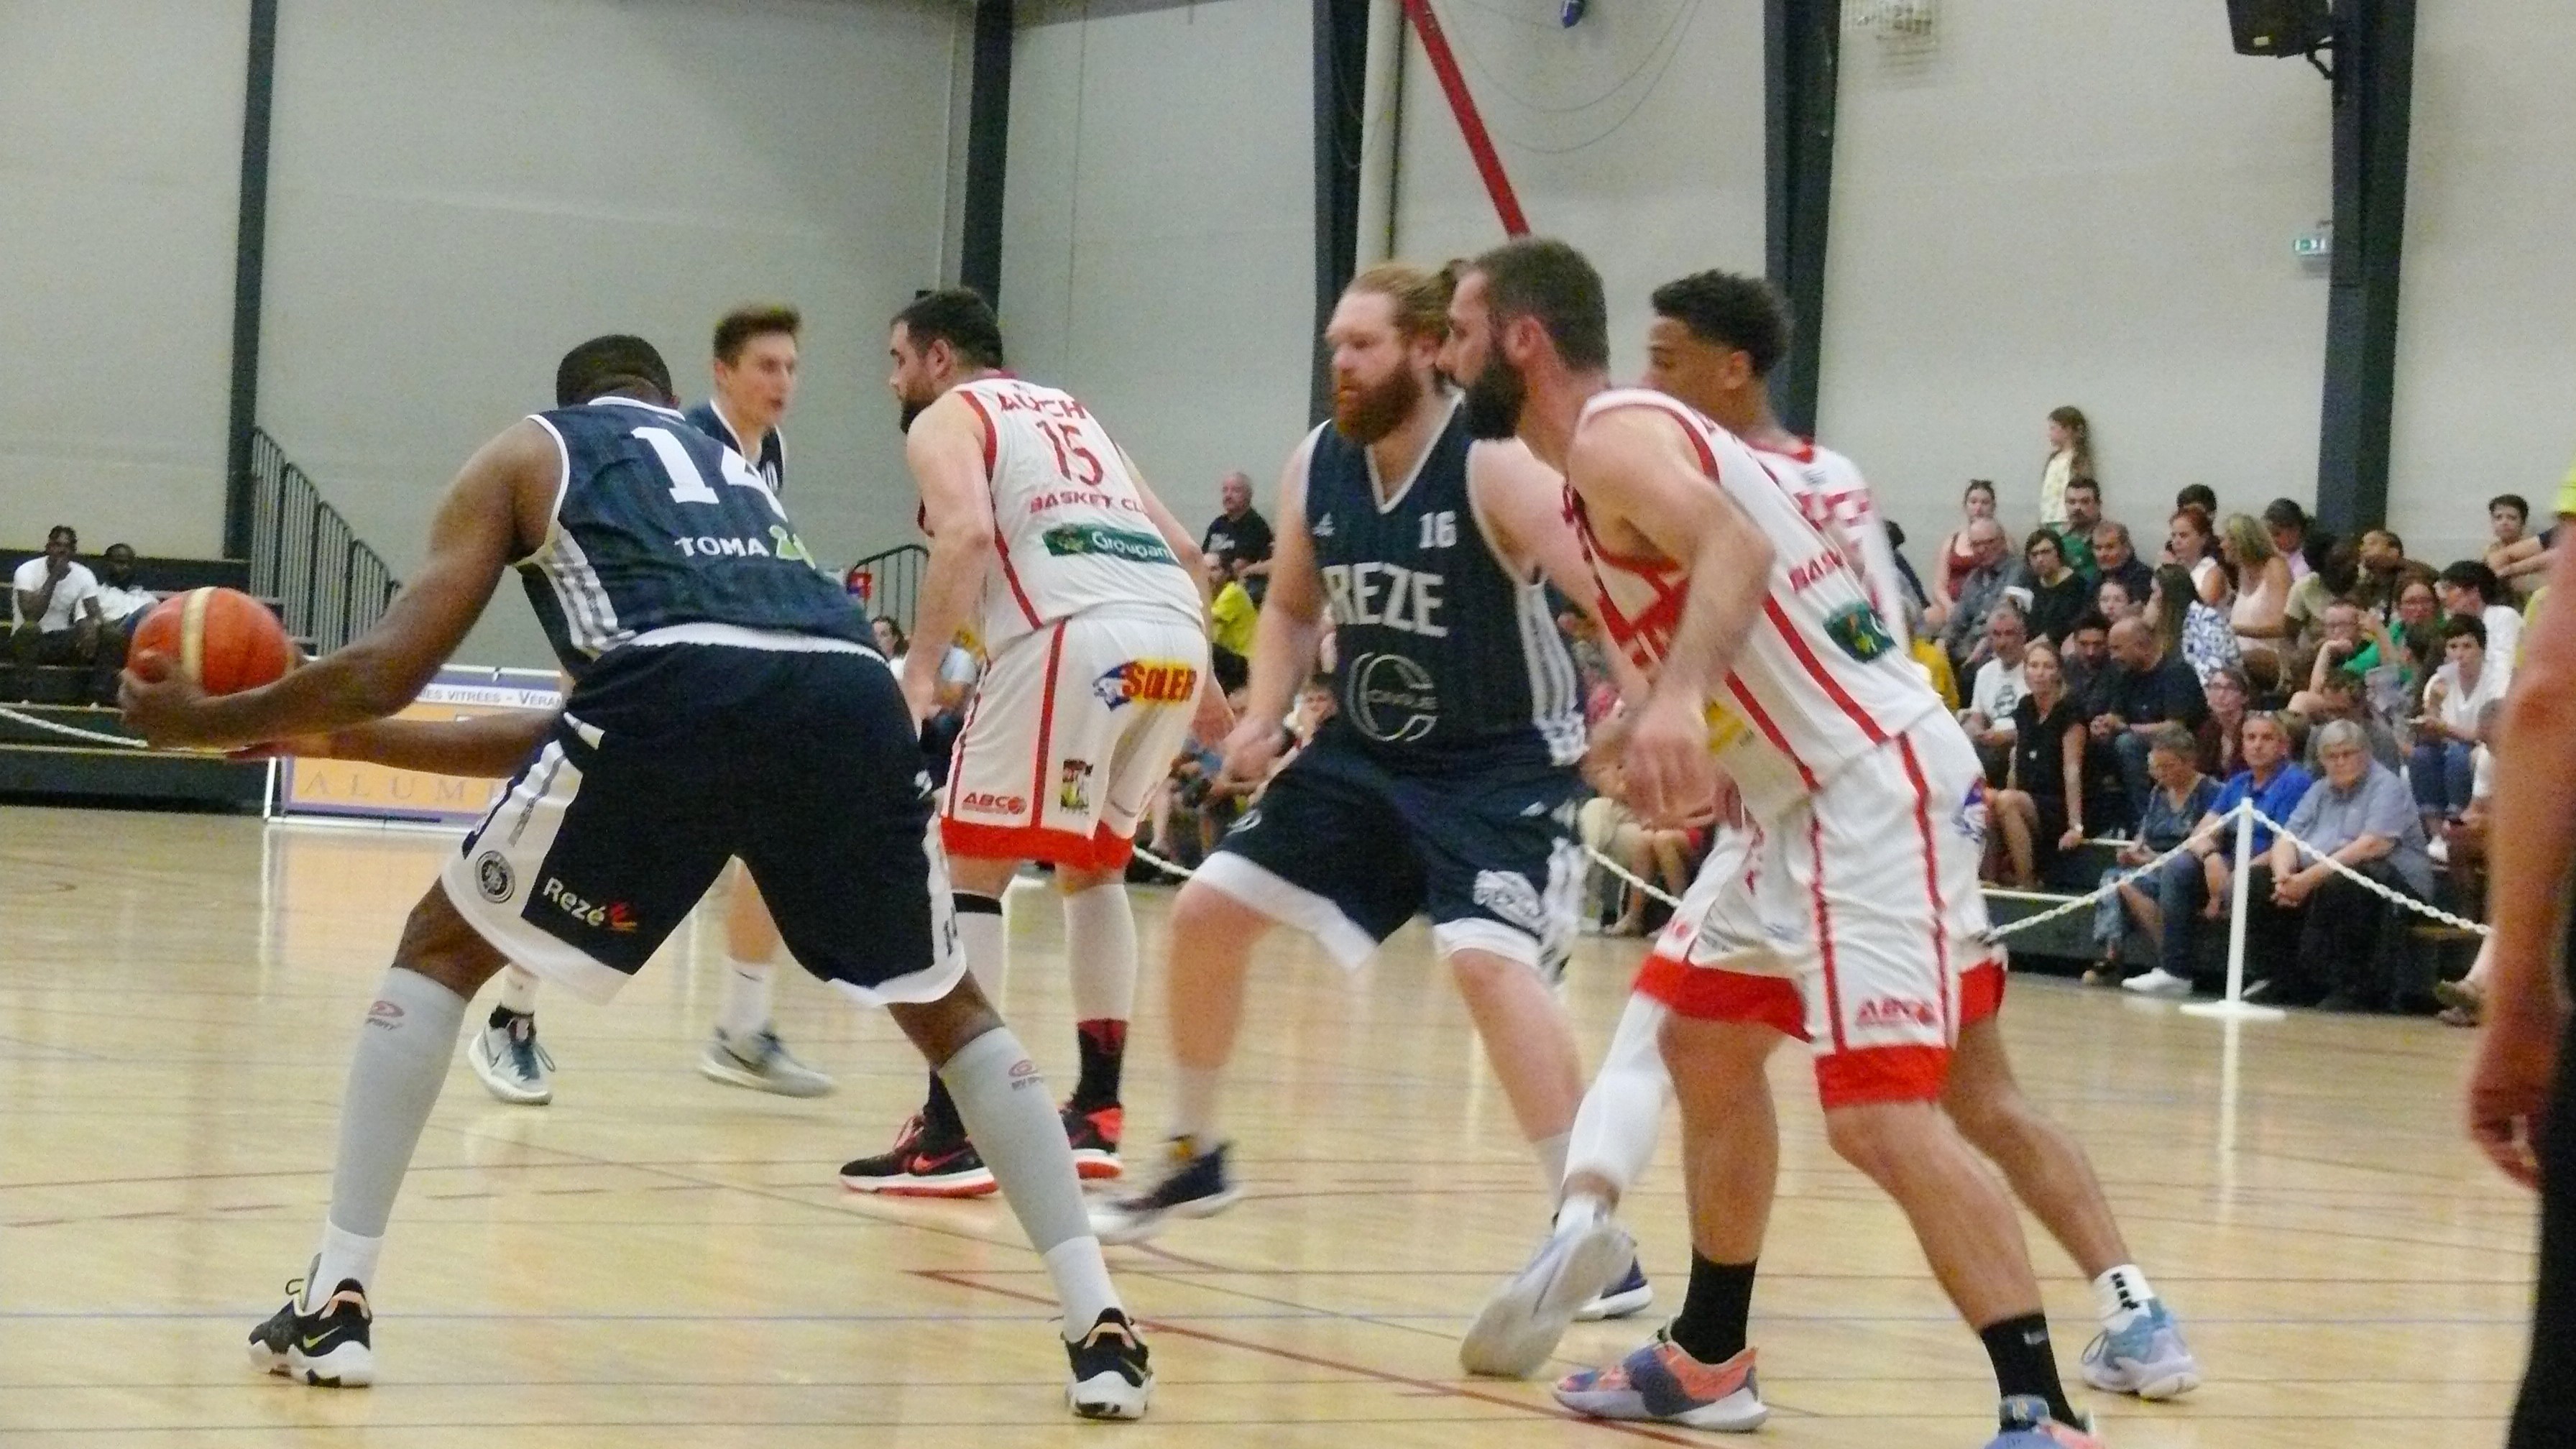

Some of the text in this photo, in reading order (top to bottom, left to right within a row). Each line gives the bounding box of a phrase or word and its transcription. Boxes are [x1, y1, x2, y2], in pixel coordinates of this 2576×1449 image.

[996, 391, 1087, 419] AUCH
[1035, 419, 1104, 486] 15
[1029, 491, 1113, 514] BASKET
[674, 535, 770, 558] TOMA
[1418, 510, 1457, 549] 16
[1321, 561, 1449, 638] REZE
[1122, 661, 1198, 702] SOLER
[543, 877, 607, 927] Rezé
